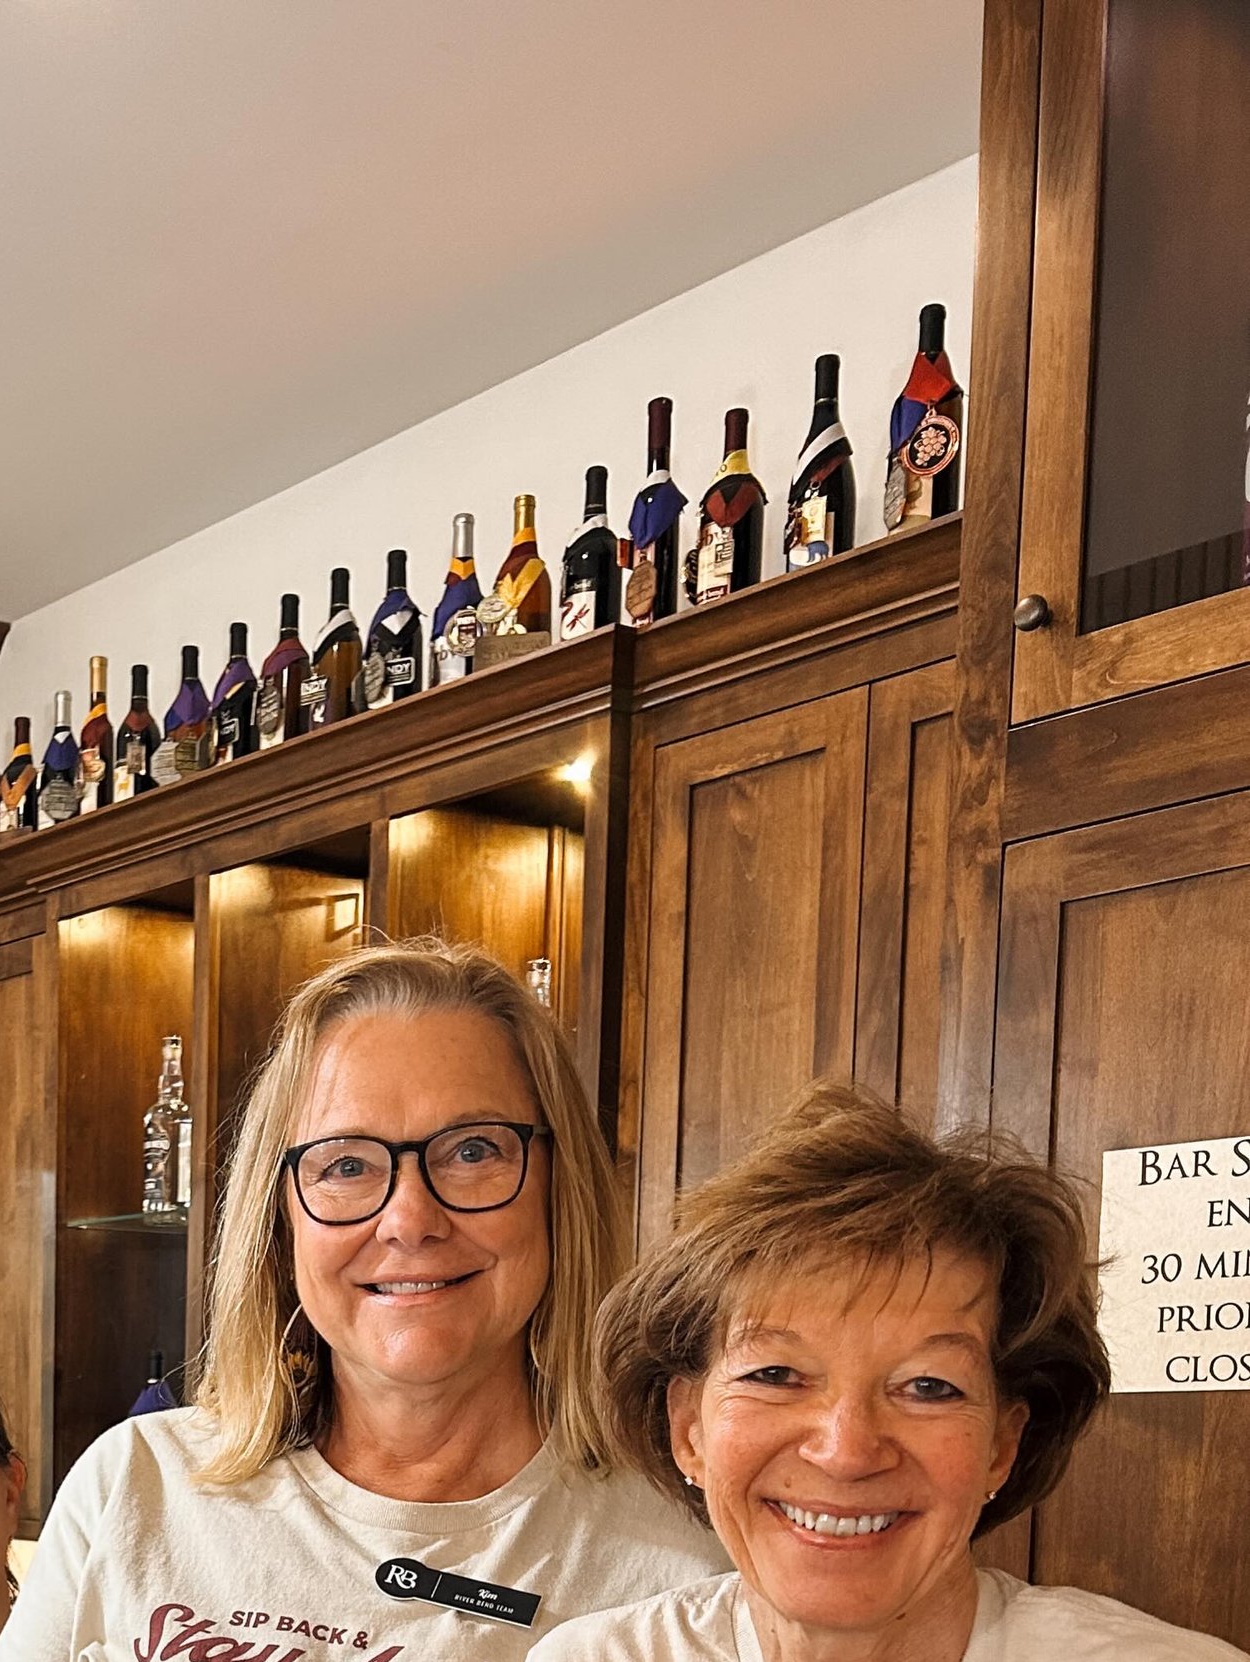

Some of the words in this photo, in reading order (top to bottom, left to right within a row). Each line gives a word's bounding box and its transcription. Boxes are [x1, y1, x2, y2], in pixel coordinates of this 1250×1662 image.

[1138, 1150, 1217, 1186] BAR
[1141, 1253, 1182, 1284] 30
[1157, 1302, 1250, 1333] PRIO
[478, 1588, 498, 1600] Kim
[229, 1610, 269, 1630] SIP
[276, 1611, 346, 1646] BACK
[352, 1631, 370, 1650] &
